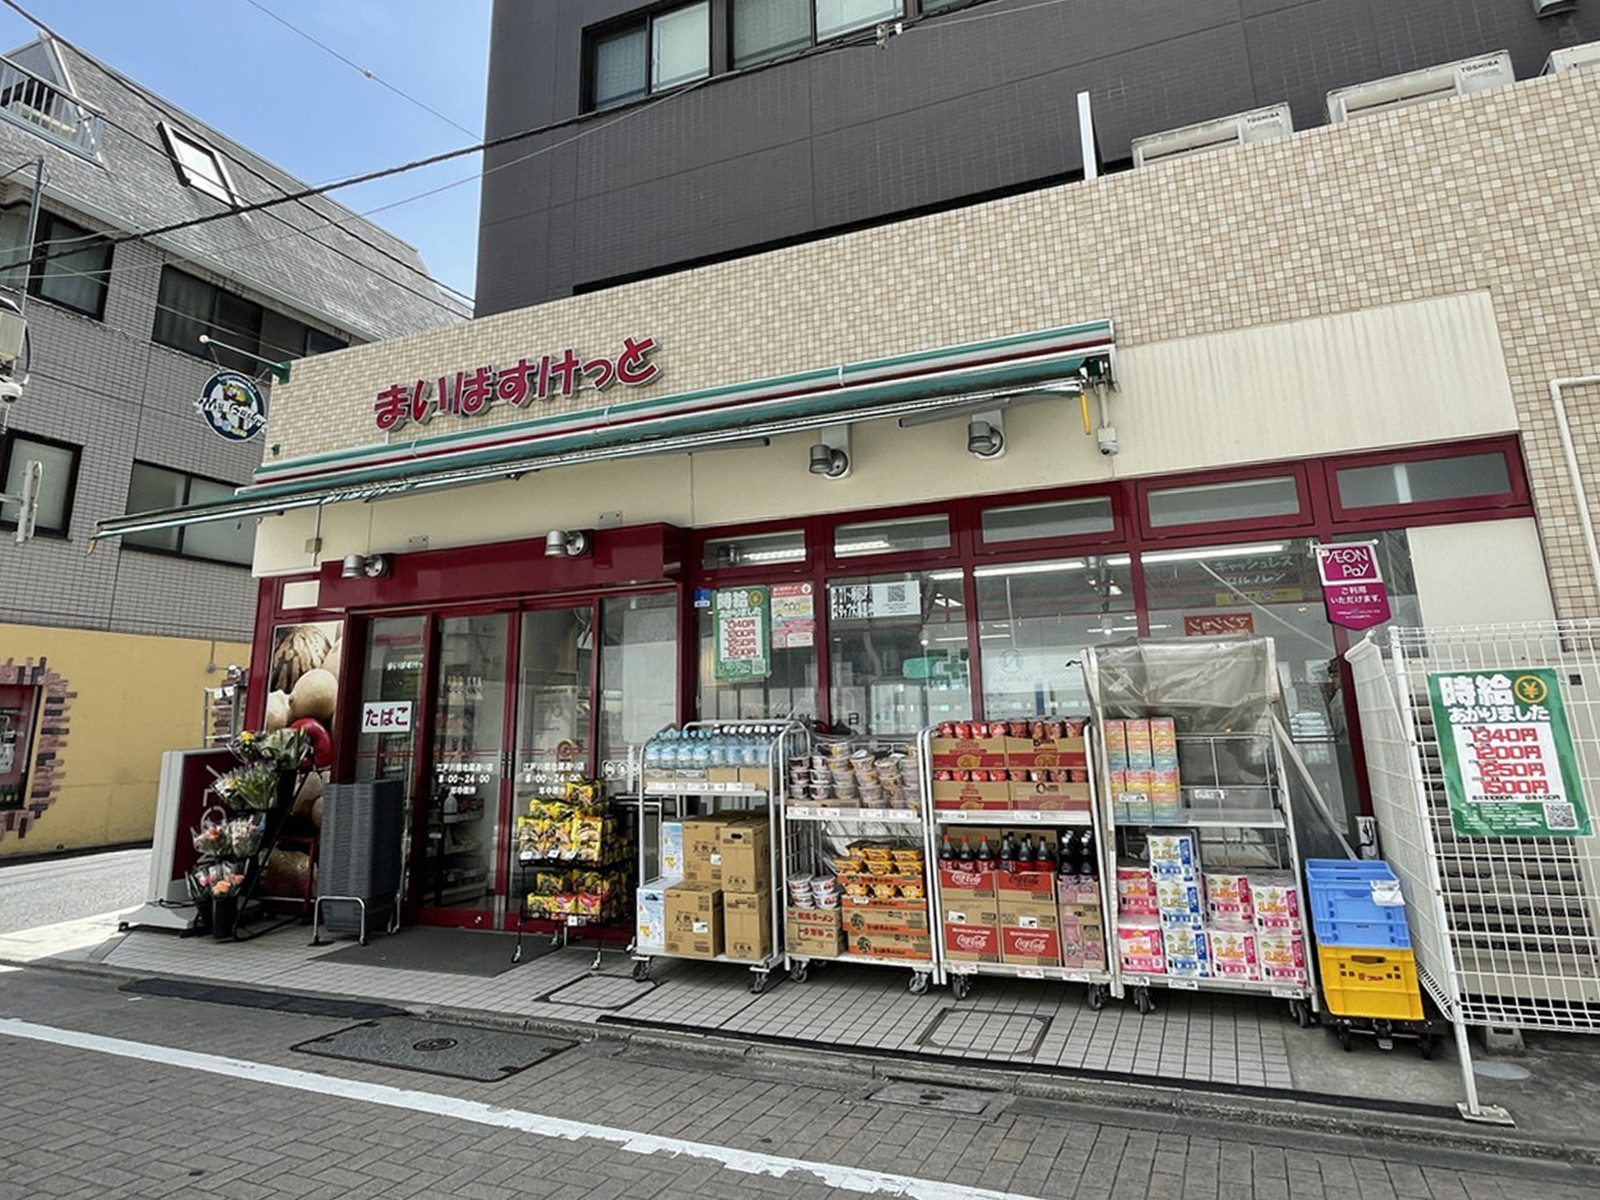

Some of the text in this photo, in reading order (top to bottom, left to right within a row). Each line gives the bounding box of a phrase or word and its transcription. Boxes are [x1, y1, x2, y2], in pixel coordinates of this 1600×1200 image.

[1461, 60, 1499, 73] TOSHIBA
[1247, 112, 1280, 123] TOSHIBA
[373, 336, 660, 431] まいばすけっと
[717, 590, 749, 609] 時給
[1438, 674, 1515, 706] 時給
[365, 707, 408, 727] たばこ
[1449, 705, 1550, 723] あがりました
[1474, 745, 1542, 759] 1200円
[1478, 762, 1546, 777] 1250円
[1482, 779, 1550, 794] 1500円
[956, 933, 988, 949] Coca-Cola
[1014, 937, 1047, 952] Coca-Cola
